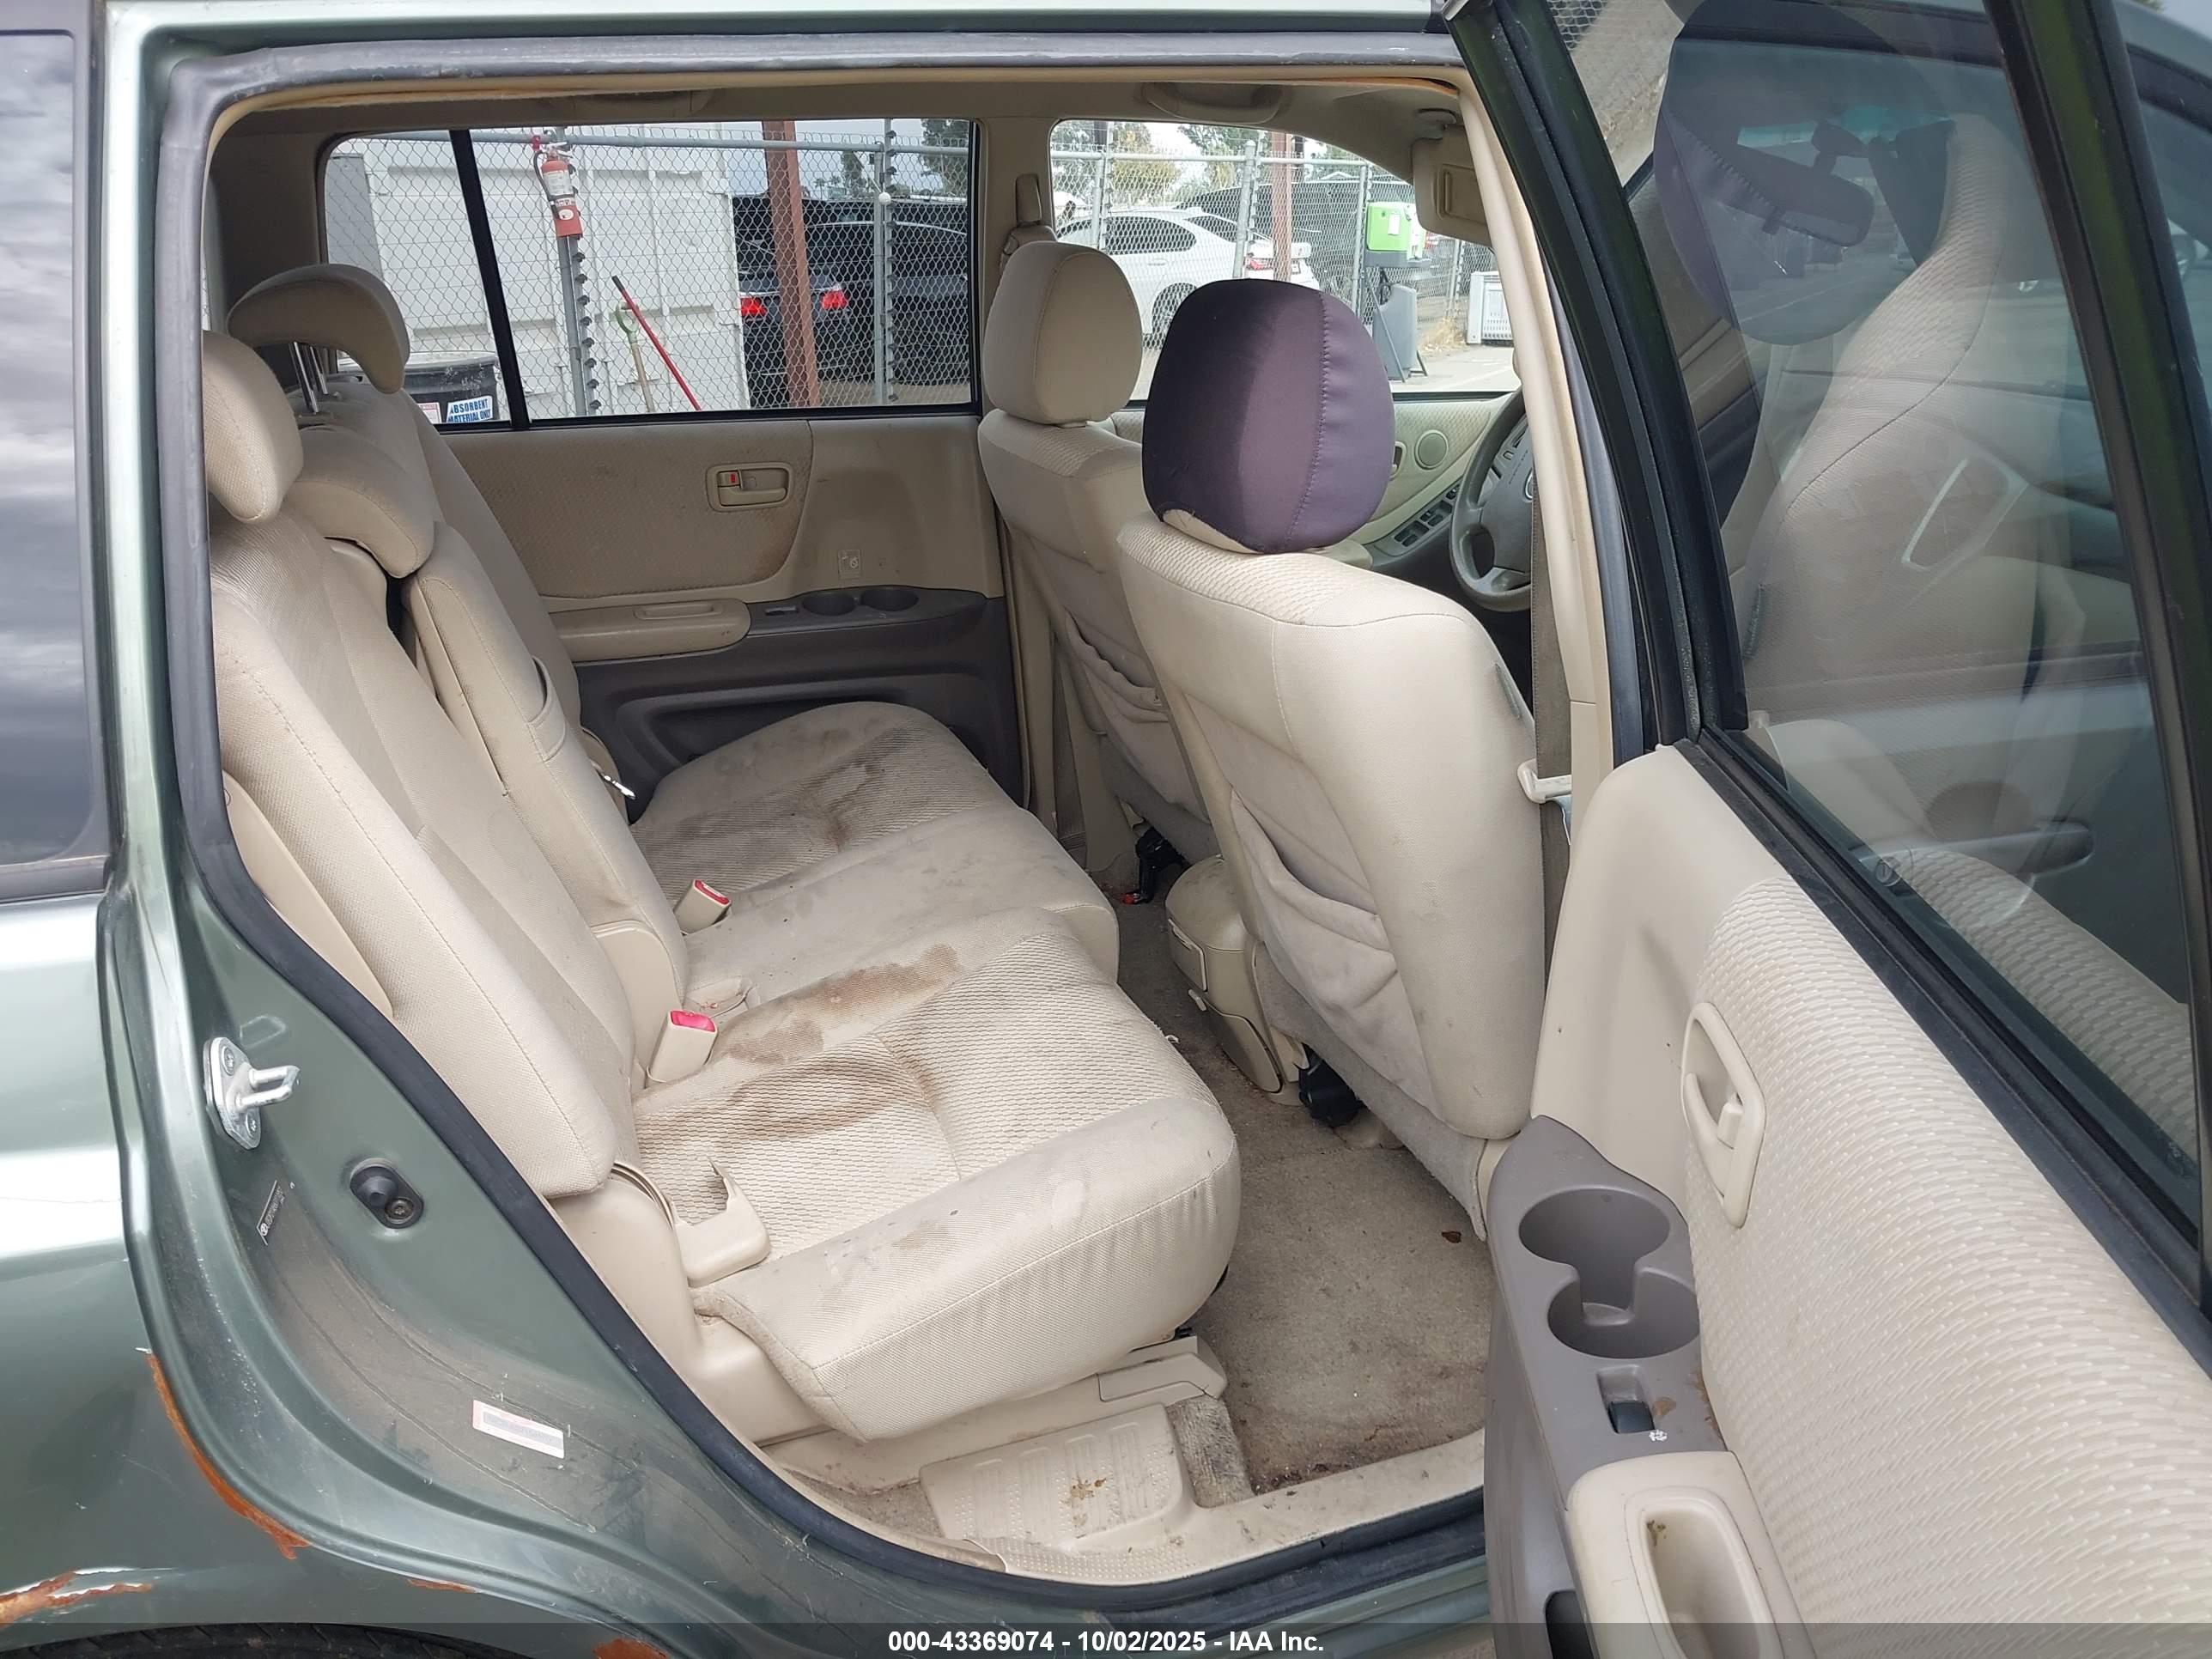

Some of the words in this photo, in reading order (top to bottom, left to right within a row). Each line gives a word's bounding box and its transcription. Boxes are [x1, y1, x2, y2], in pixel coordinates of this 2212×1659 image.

[450, 398, 488, 414] ABSORBENT
[448, 411, 479, 422] MATERIAL
[479, 409, 491, 420] ONLY
